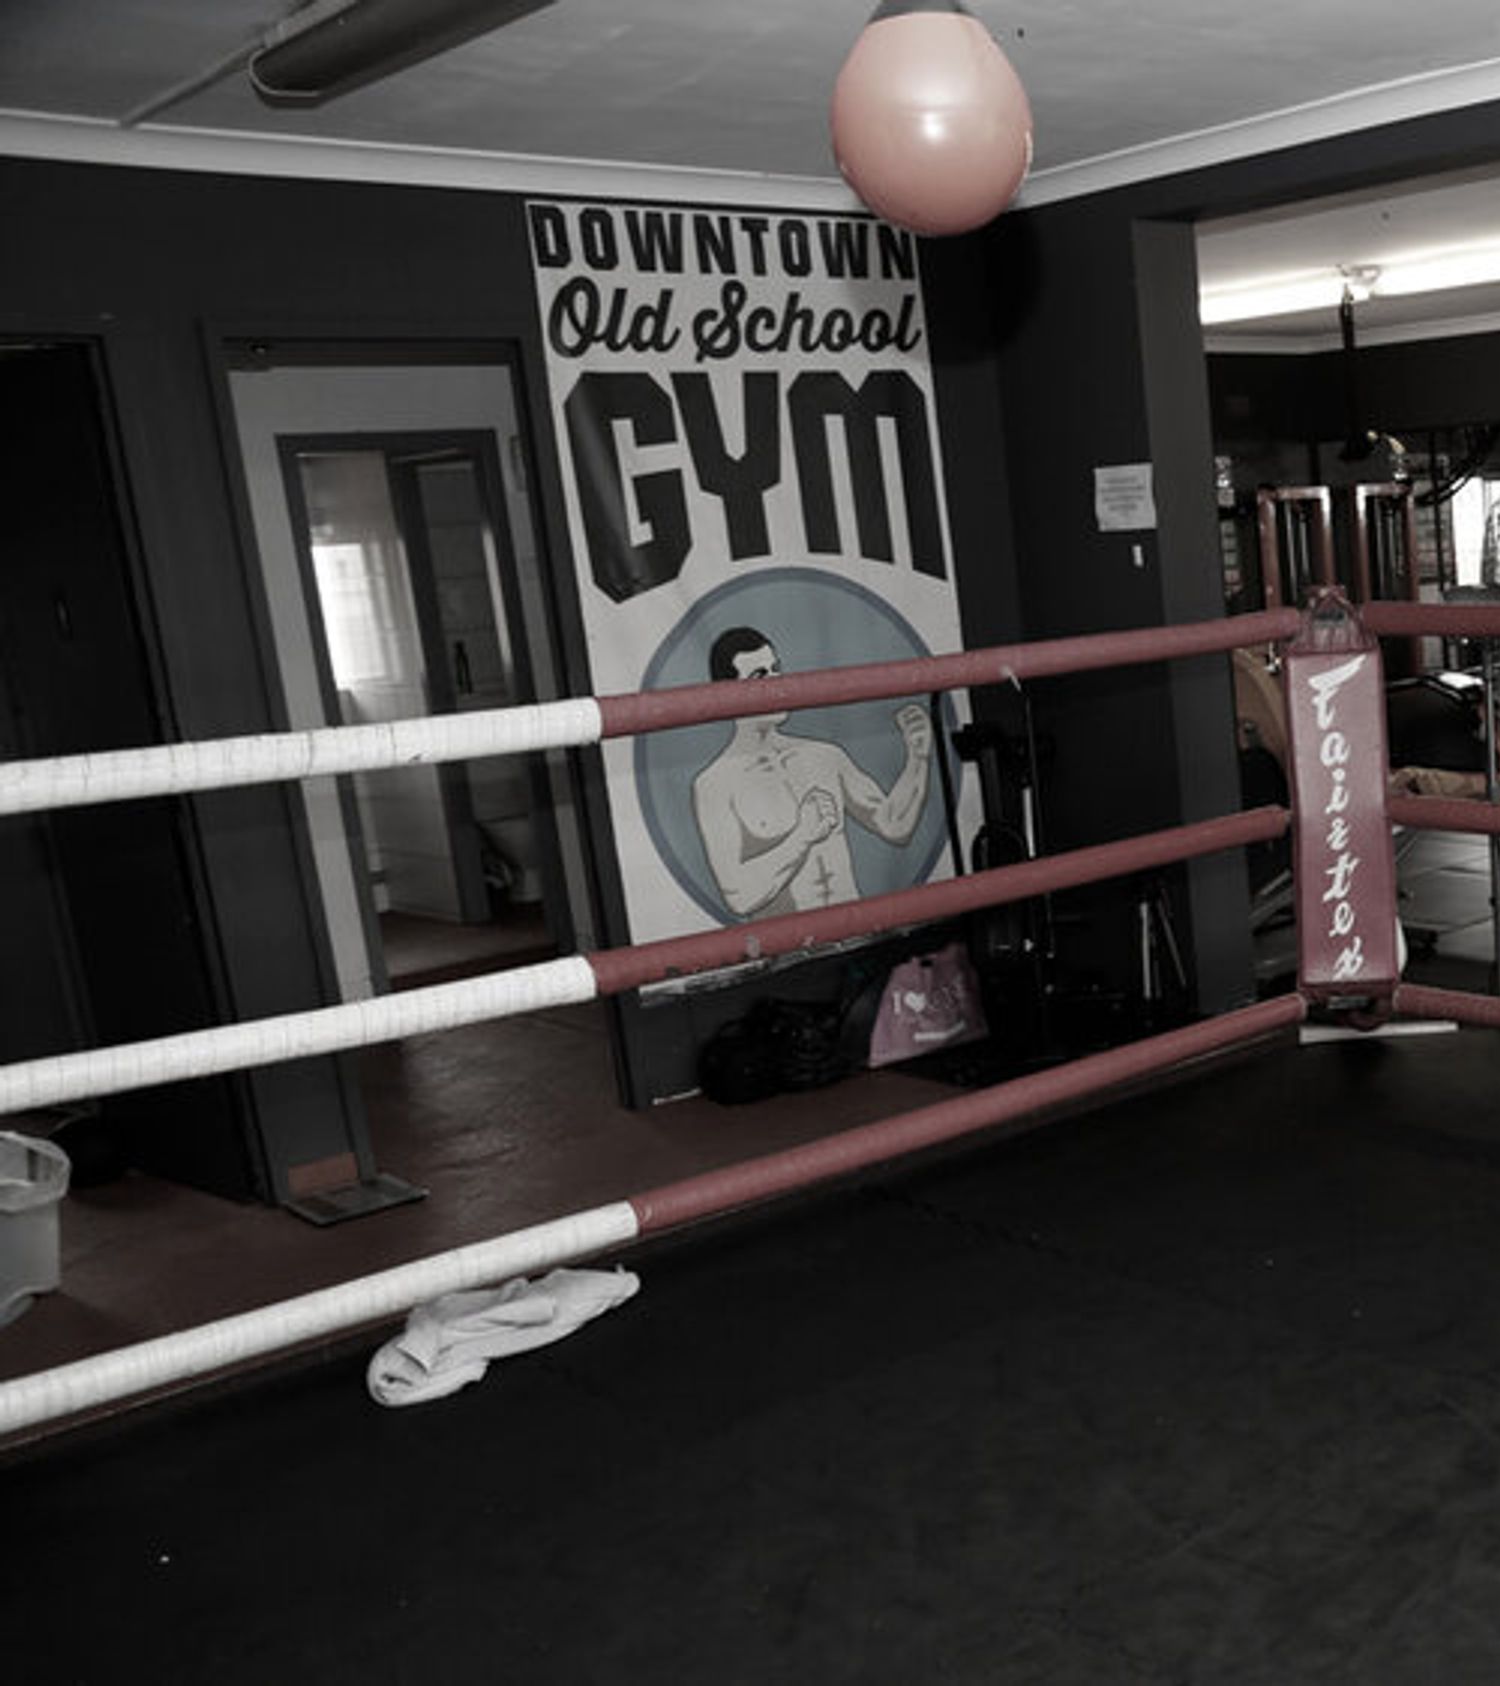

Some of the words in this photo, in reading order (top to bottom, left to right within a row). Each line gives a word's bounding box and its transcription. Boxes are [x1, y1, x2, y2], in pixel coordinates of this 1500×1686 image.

[528, 204, 917, 280] DOWNTOWN
[548, 276, 680, 357] Old
[692, 280, 922, 362] School
[564, 369, 948, 603] GYM
[1308, 654, 1365, 980] Fairtex
